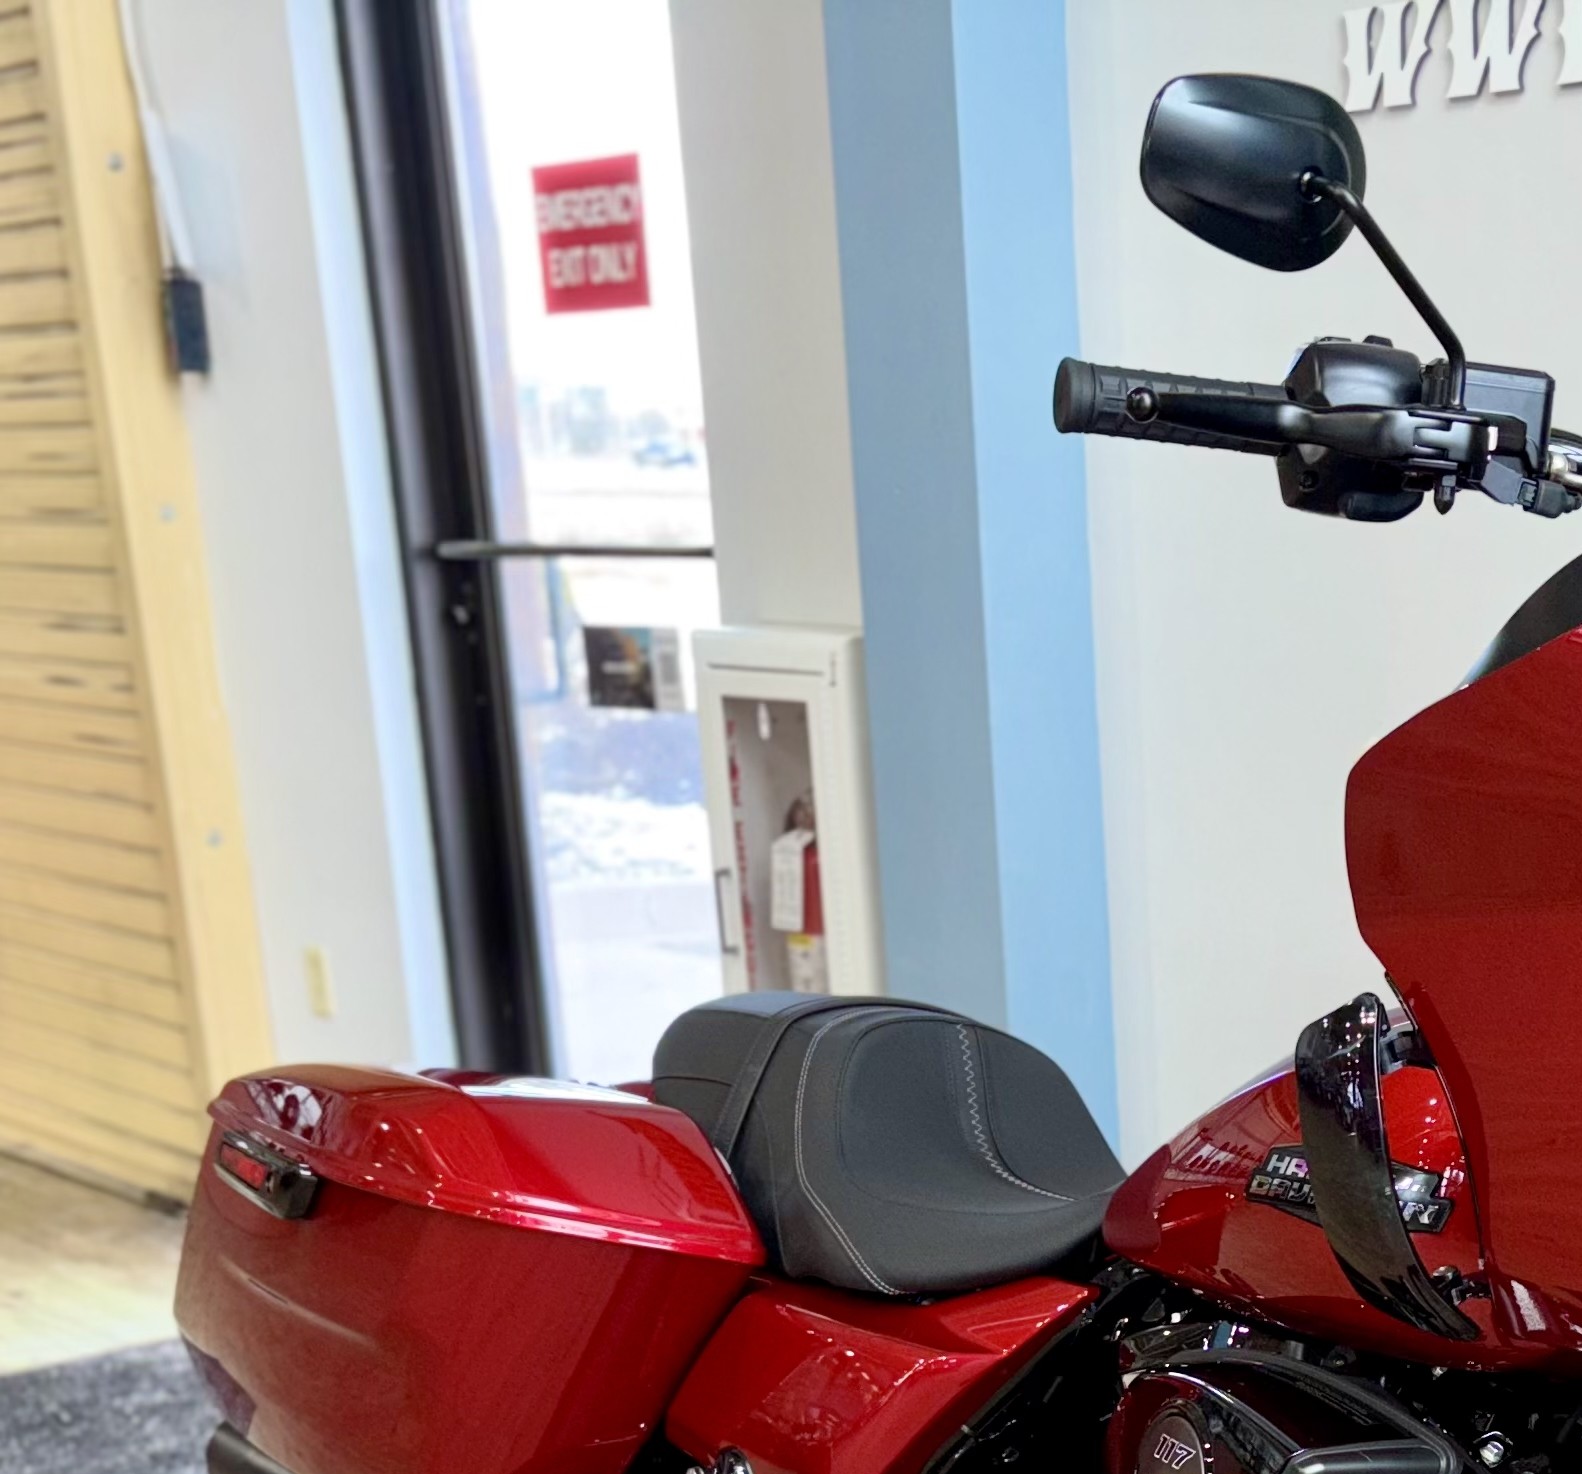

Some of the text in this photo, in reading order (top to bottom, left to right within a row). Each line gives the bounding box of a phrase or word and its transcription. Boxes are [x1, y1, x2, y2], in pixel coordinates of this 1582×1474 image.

[550, 239, 637, 289] EXIT ONLY
[1152, 1432, 1197, 1470] 117
